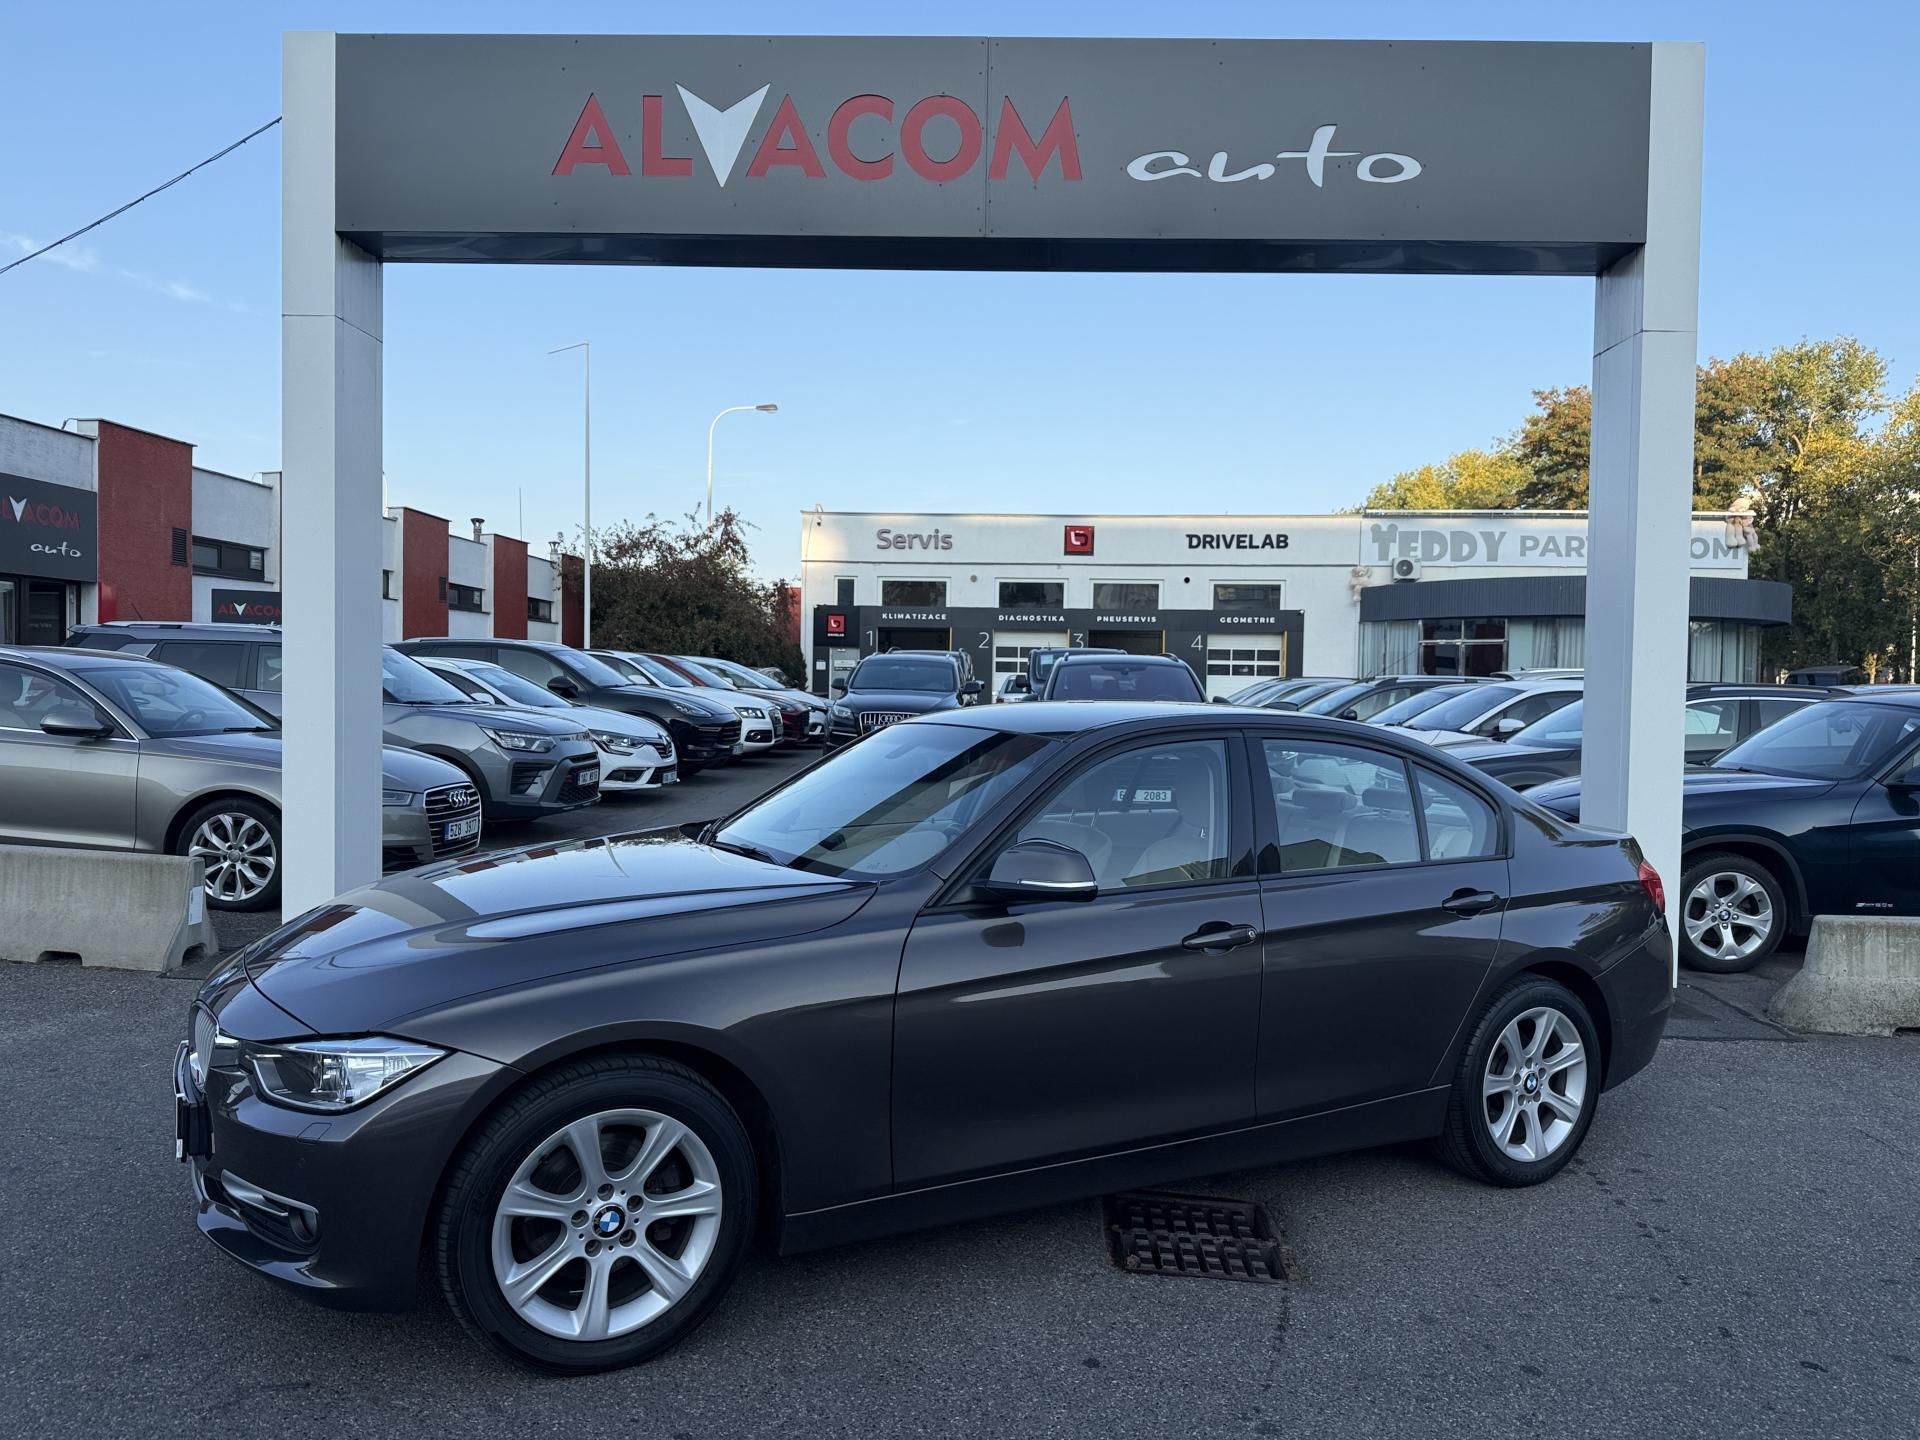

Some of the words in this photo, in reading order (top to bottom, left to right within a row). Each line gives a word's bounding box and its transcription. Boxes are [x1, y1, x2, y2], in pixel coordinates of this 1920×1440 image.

[1126, 124, 1423, 188] auto
[876, 528, 953, 550] Servis
[1185, 533, 1289, 550] DRIVELAB
[1370, 523, 1507, 563] TEDDY
[31, 541, 82, 558] auto
[881, 612, 947, 621] KLIMATIZACE
[998, 614, 1065, 622] DIAGNOSTIKA
[1219, 616, 1276, 624] GEOMETRIE
[866, 630, 873, 647] 1
[978, 631, 990, 649] 2
[1073, 633, 1084, 649] 3
[1190, 634, 1204, 651] 4
[1143, 791, 1167, 800] 2083
